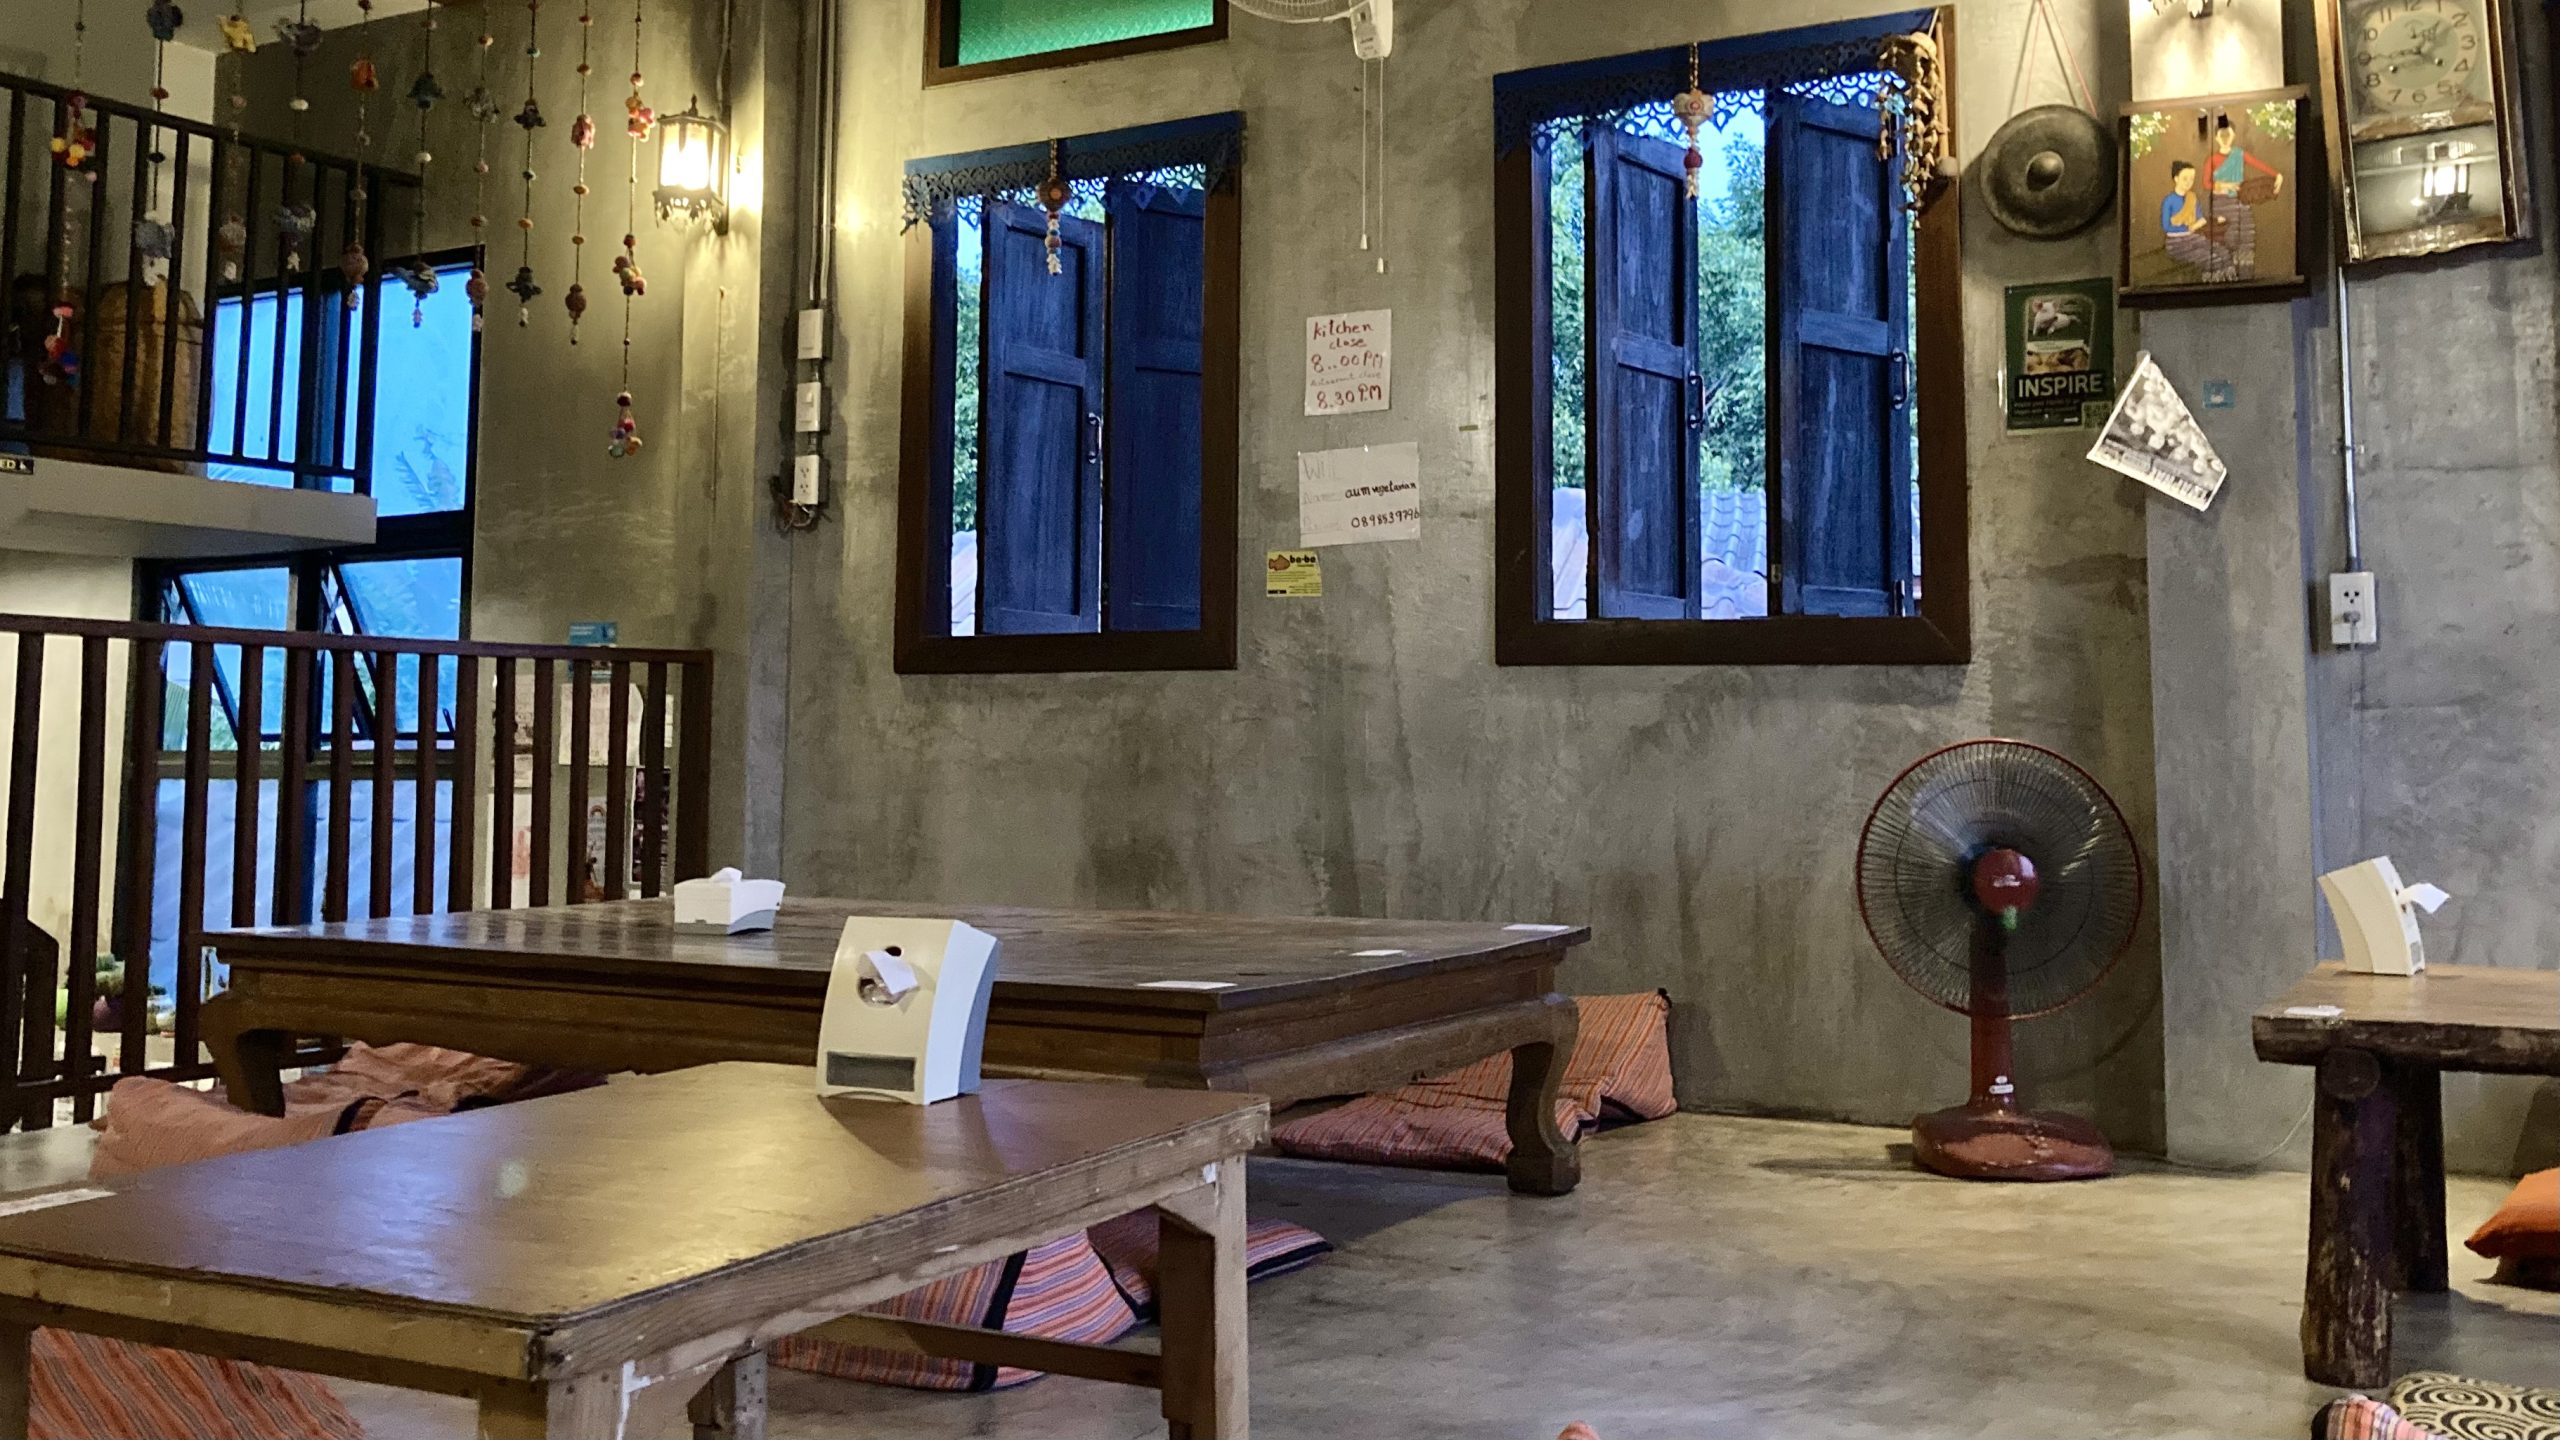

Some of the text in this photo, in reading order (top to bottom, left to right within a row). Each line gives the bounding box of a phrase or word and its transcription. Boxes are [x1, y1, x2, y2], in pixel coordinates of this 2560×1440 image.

[2380, 7, 2391, 22] 11
[2451, 11, 2469, 27] 2
[2363, 27, 2378, 41] 10
[2461, 34, 2476, 50] 3
[2454, 58, 2469, 73] 4
[2366, 72, 2381, 88] 8
[2388, 88, 2402, 103] 7
[2412, 91, 2427, 103] 6
[1313, 319, 1373, 340] kitchen
[2018, 374, 2103, 397] INSPIRE
